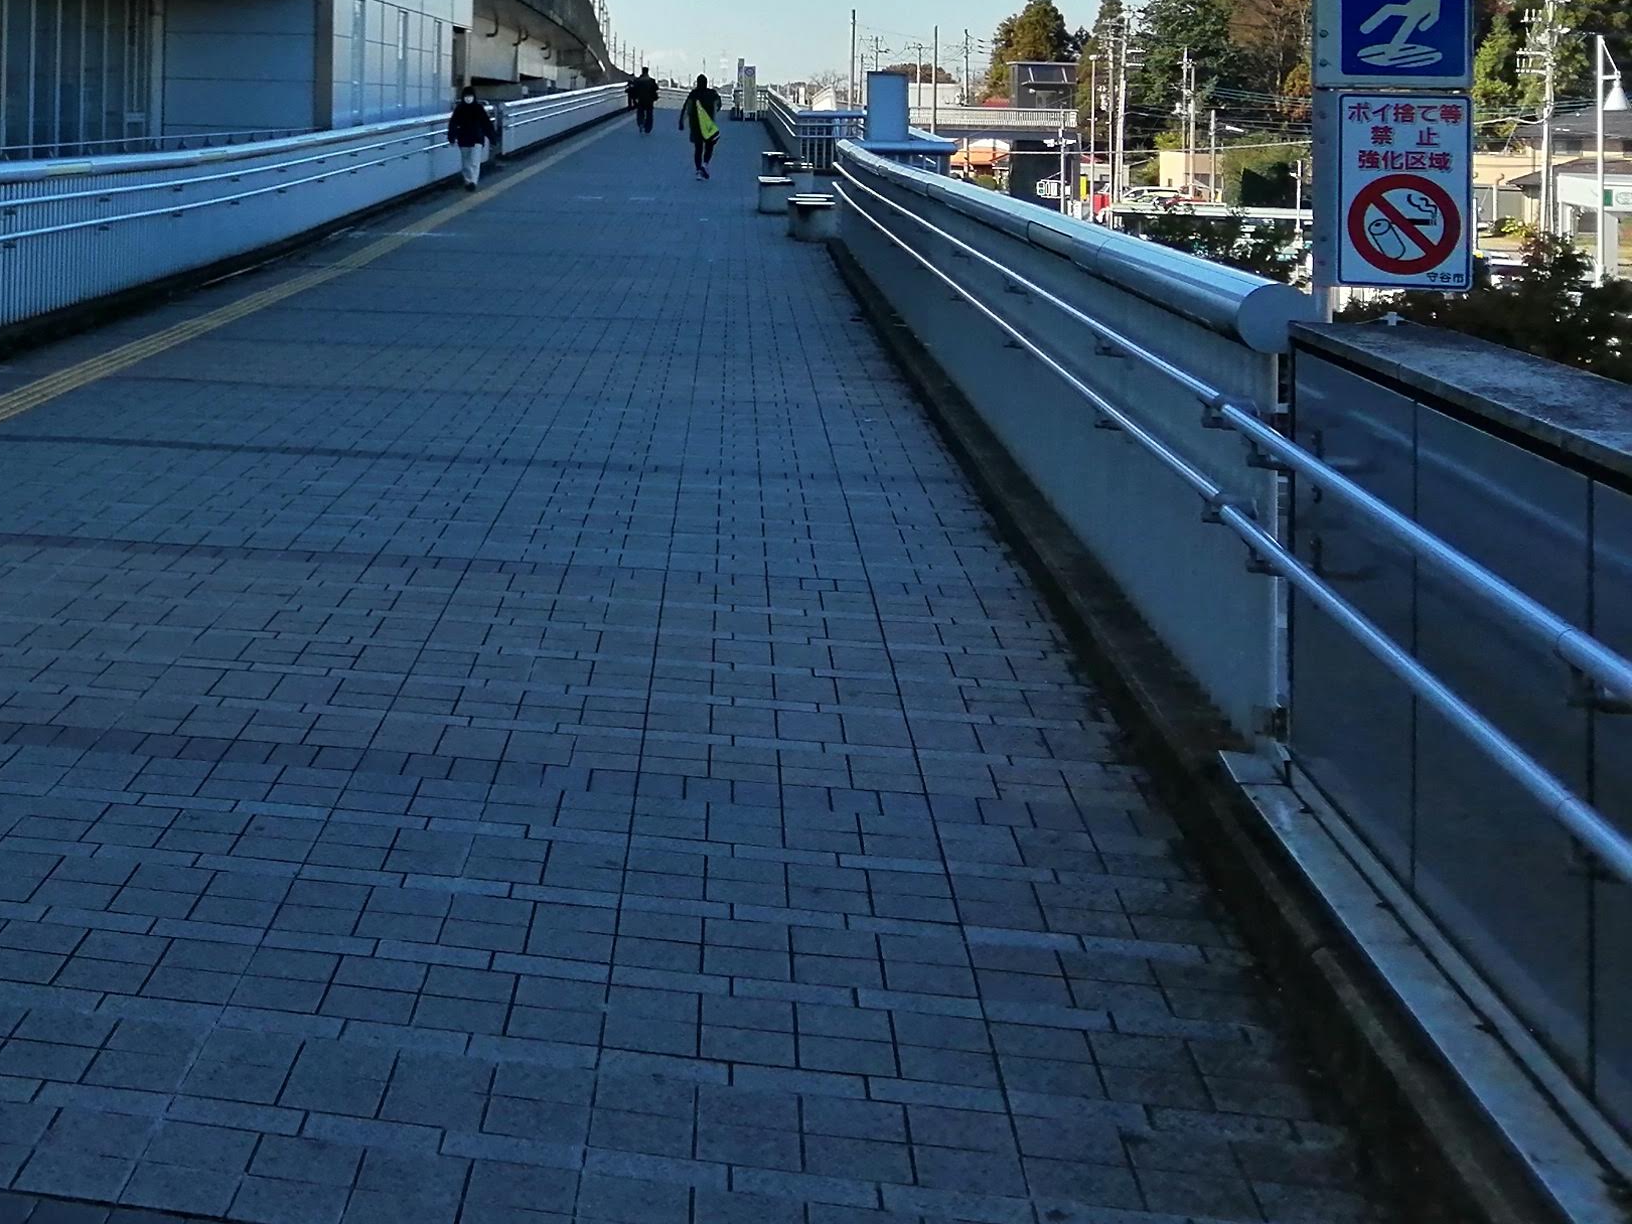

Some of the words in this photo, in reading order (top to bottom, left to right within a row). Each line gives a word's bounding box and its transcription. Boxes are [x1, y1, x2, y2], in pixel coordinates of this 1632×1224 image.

[1348, 102, 1462, 124] ポイ捨て等
[1358, 150, 1451, 171] 強化区域
[1427, 272, 1464, 283] 守谷市
